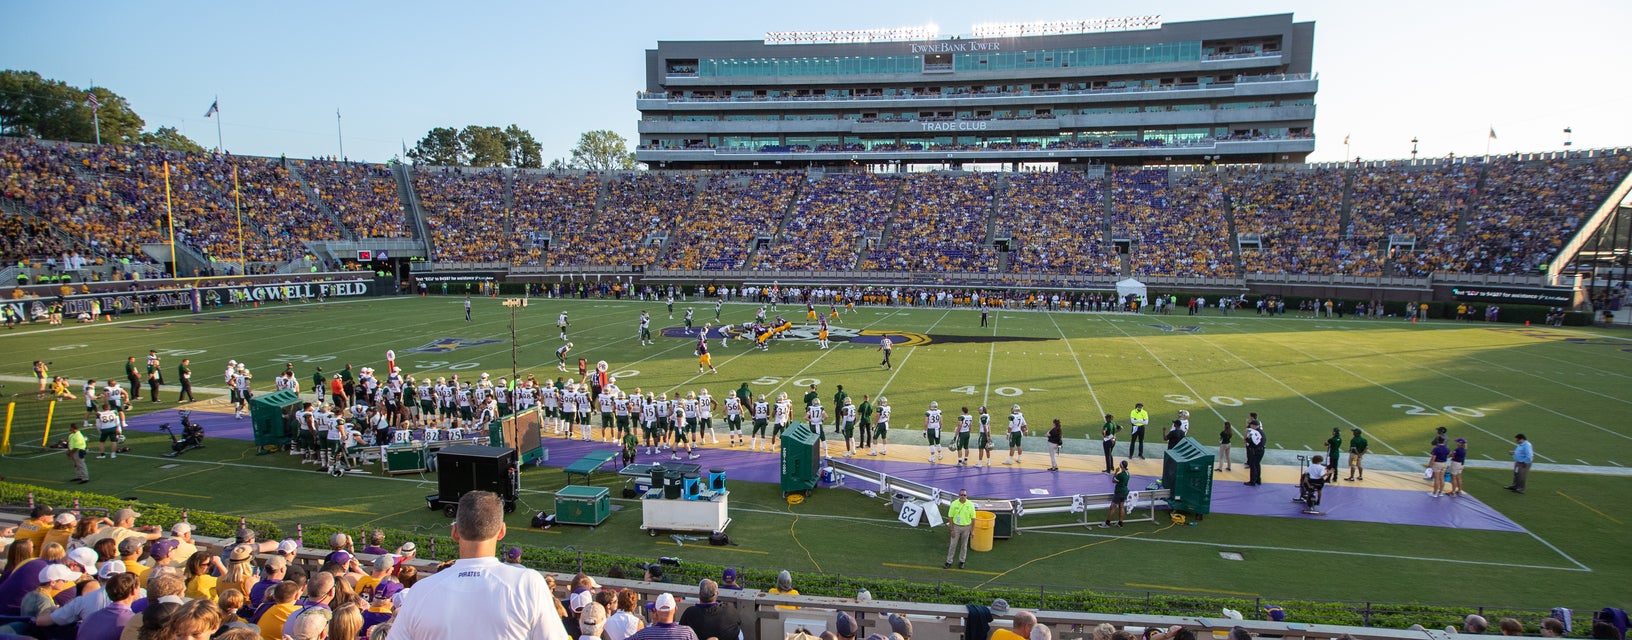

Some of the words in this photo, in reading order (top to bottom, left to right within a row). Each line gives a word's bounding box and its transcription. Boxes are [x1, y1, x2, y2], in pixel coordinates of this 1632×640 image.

[921, 122, 956, 131] TRADE
[959, 121, 987, 130] CLUB
[320, 282, 368, 299] FELD
[751, 375, 821, 387] 50
[949, 385, 1023, 397] 40
[701, 399, 710, 407] 30
[1163, 394, 1243, 407] 30
[727, 403, 738, 411] 56
[757, 406, 767, 414] 33
[1391, 403, 1486, 417] 20
[645, 408, 654, 417] 15
[812, 410, 820, 418] 17
[930, 415, 940, 424] 39
[426, 432, 437, 440] 82
[451, 432, 460, 440] 25
[901, 506, 917, 522] 23
